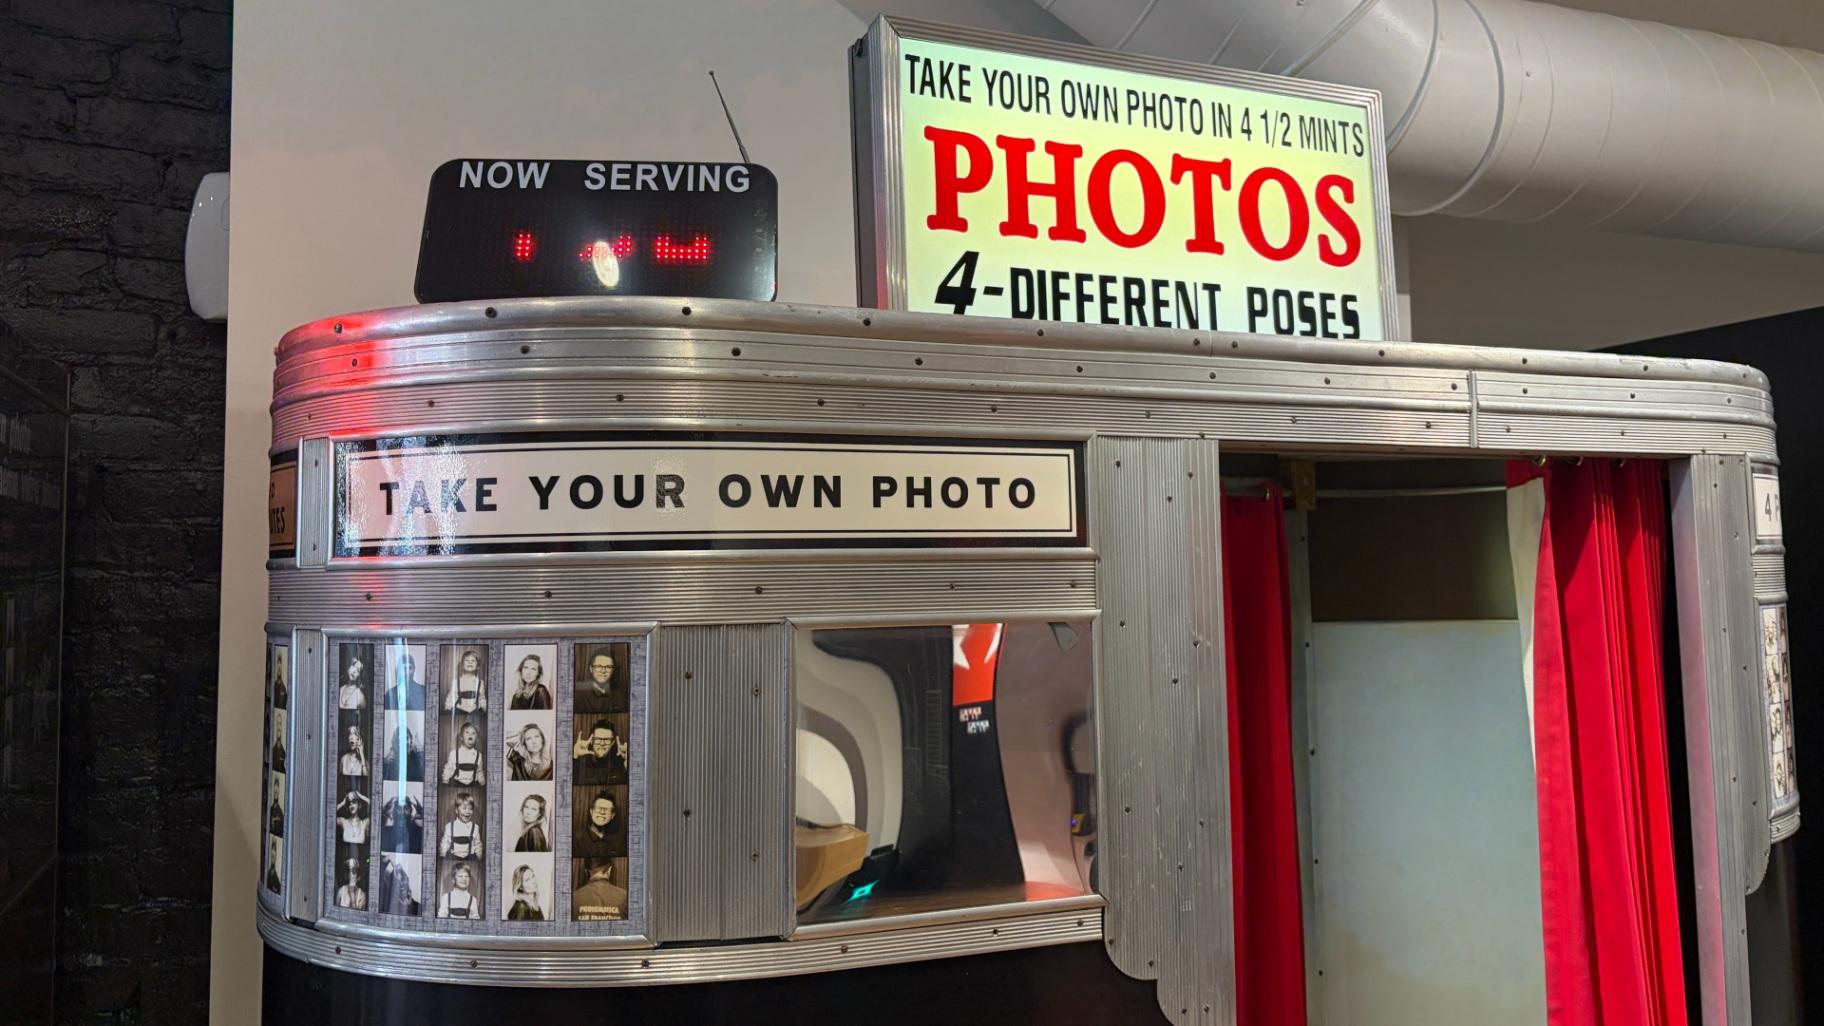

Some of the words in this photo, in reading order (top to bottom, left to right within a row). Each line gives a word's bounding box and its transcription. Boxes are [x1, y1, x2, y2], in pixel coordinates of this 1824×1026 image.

[904, 53, 972, 104] TAKE
[982, 67, 1051, 115] YOUR
[1060, 79, 1119, 124] OWN
[1126, 89, 1204, 136] PHOTO
[1211, 101, 1232, 139] IN
[1240, 107, 1252, 142] 4
[1260, 110, 1292, 148] 1/2
[1299, 114, 1364, 158] MINTS
[459, 161, 550, 190] NOW
[584, 163, 750, 193] SERVING
[923, 125, 1362, 268] PHOTOS
[1246, 286, 1361, 340] POSES
[380, 477, 498, 516] TAKE
[528, 474, 686, 511] YOUR
[718, 473, 842, 509] OWN
[872, 475, 1036, 509] PHOTO
